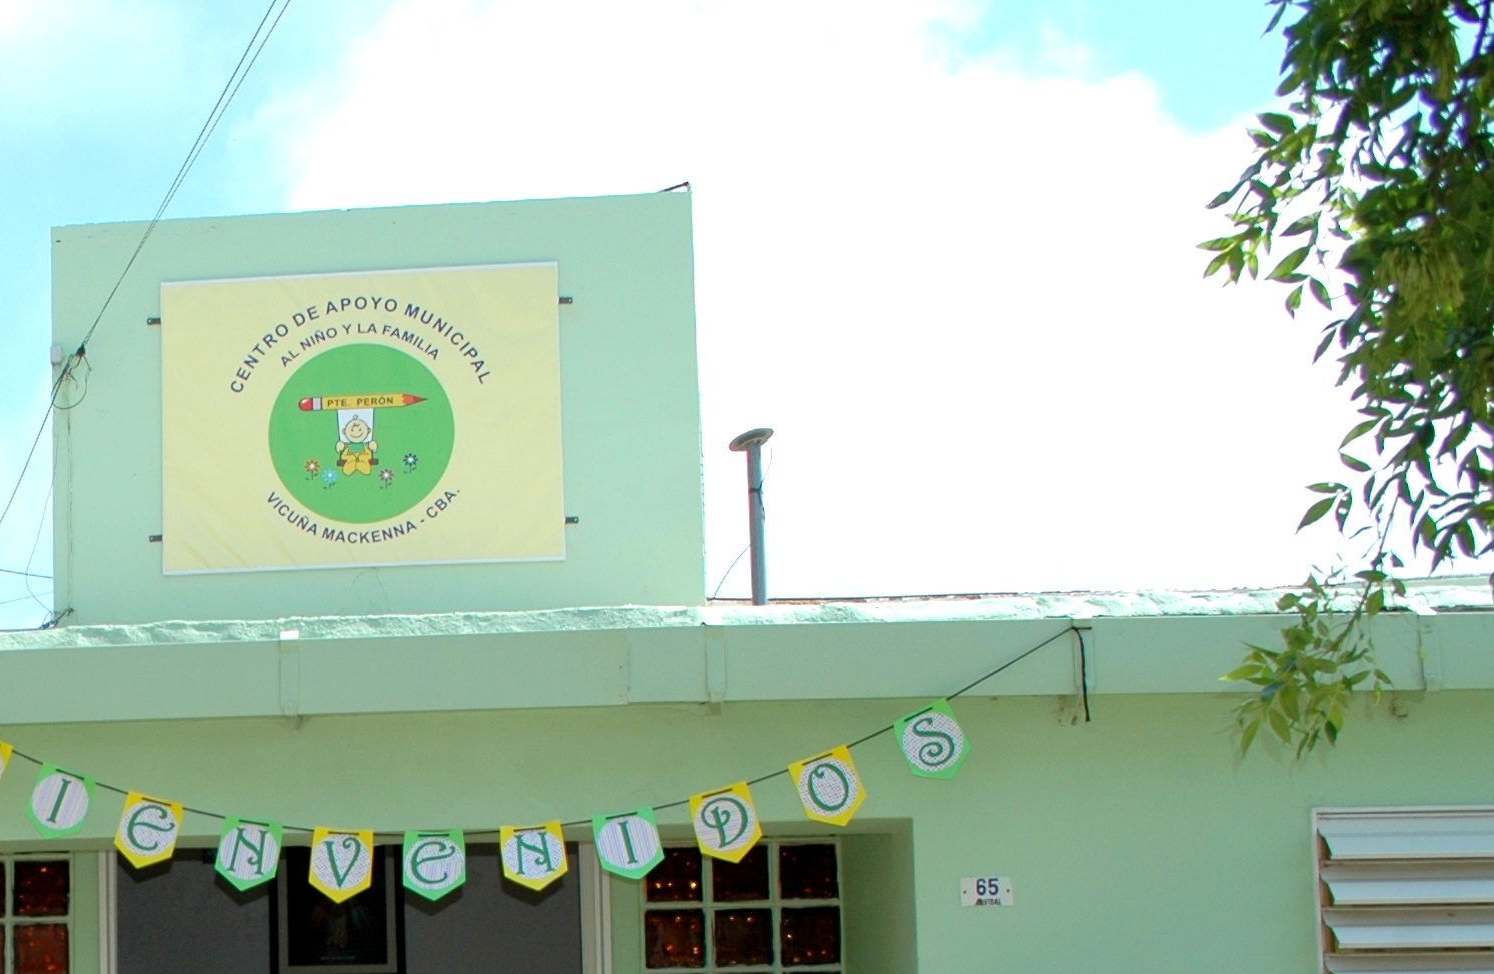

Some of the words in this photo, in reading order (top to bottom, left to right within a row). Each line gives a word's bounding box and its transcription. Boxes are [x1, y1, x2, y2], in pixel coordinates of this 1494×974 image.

[230, 323, 289, 394] CENTRO
[292, 306, 320, 328] DE
[326, 297, 398, 316] APOYO
[404, 302, 491, 385] MUNICIPAL
[279, 349, 299, 368] AL
[299, 326, 338, 350] NIÑO
[342, 324, 352, 335] Y
[357, 323, 378, 335] LA
[382, 324, 440, 361] FAMILIA
[327, 398, 351, 408] PTE.
[356, 395, 394, 406] PERÓN
[266, 491, 318, 536] VICUÑA
[321, 520, 417, 544] MACKENNA
[426, 489, 461, 519] CBA.
[976, 878, 999, 896] 65
